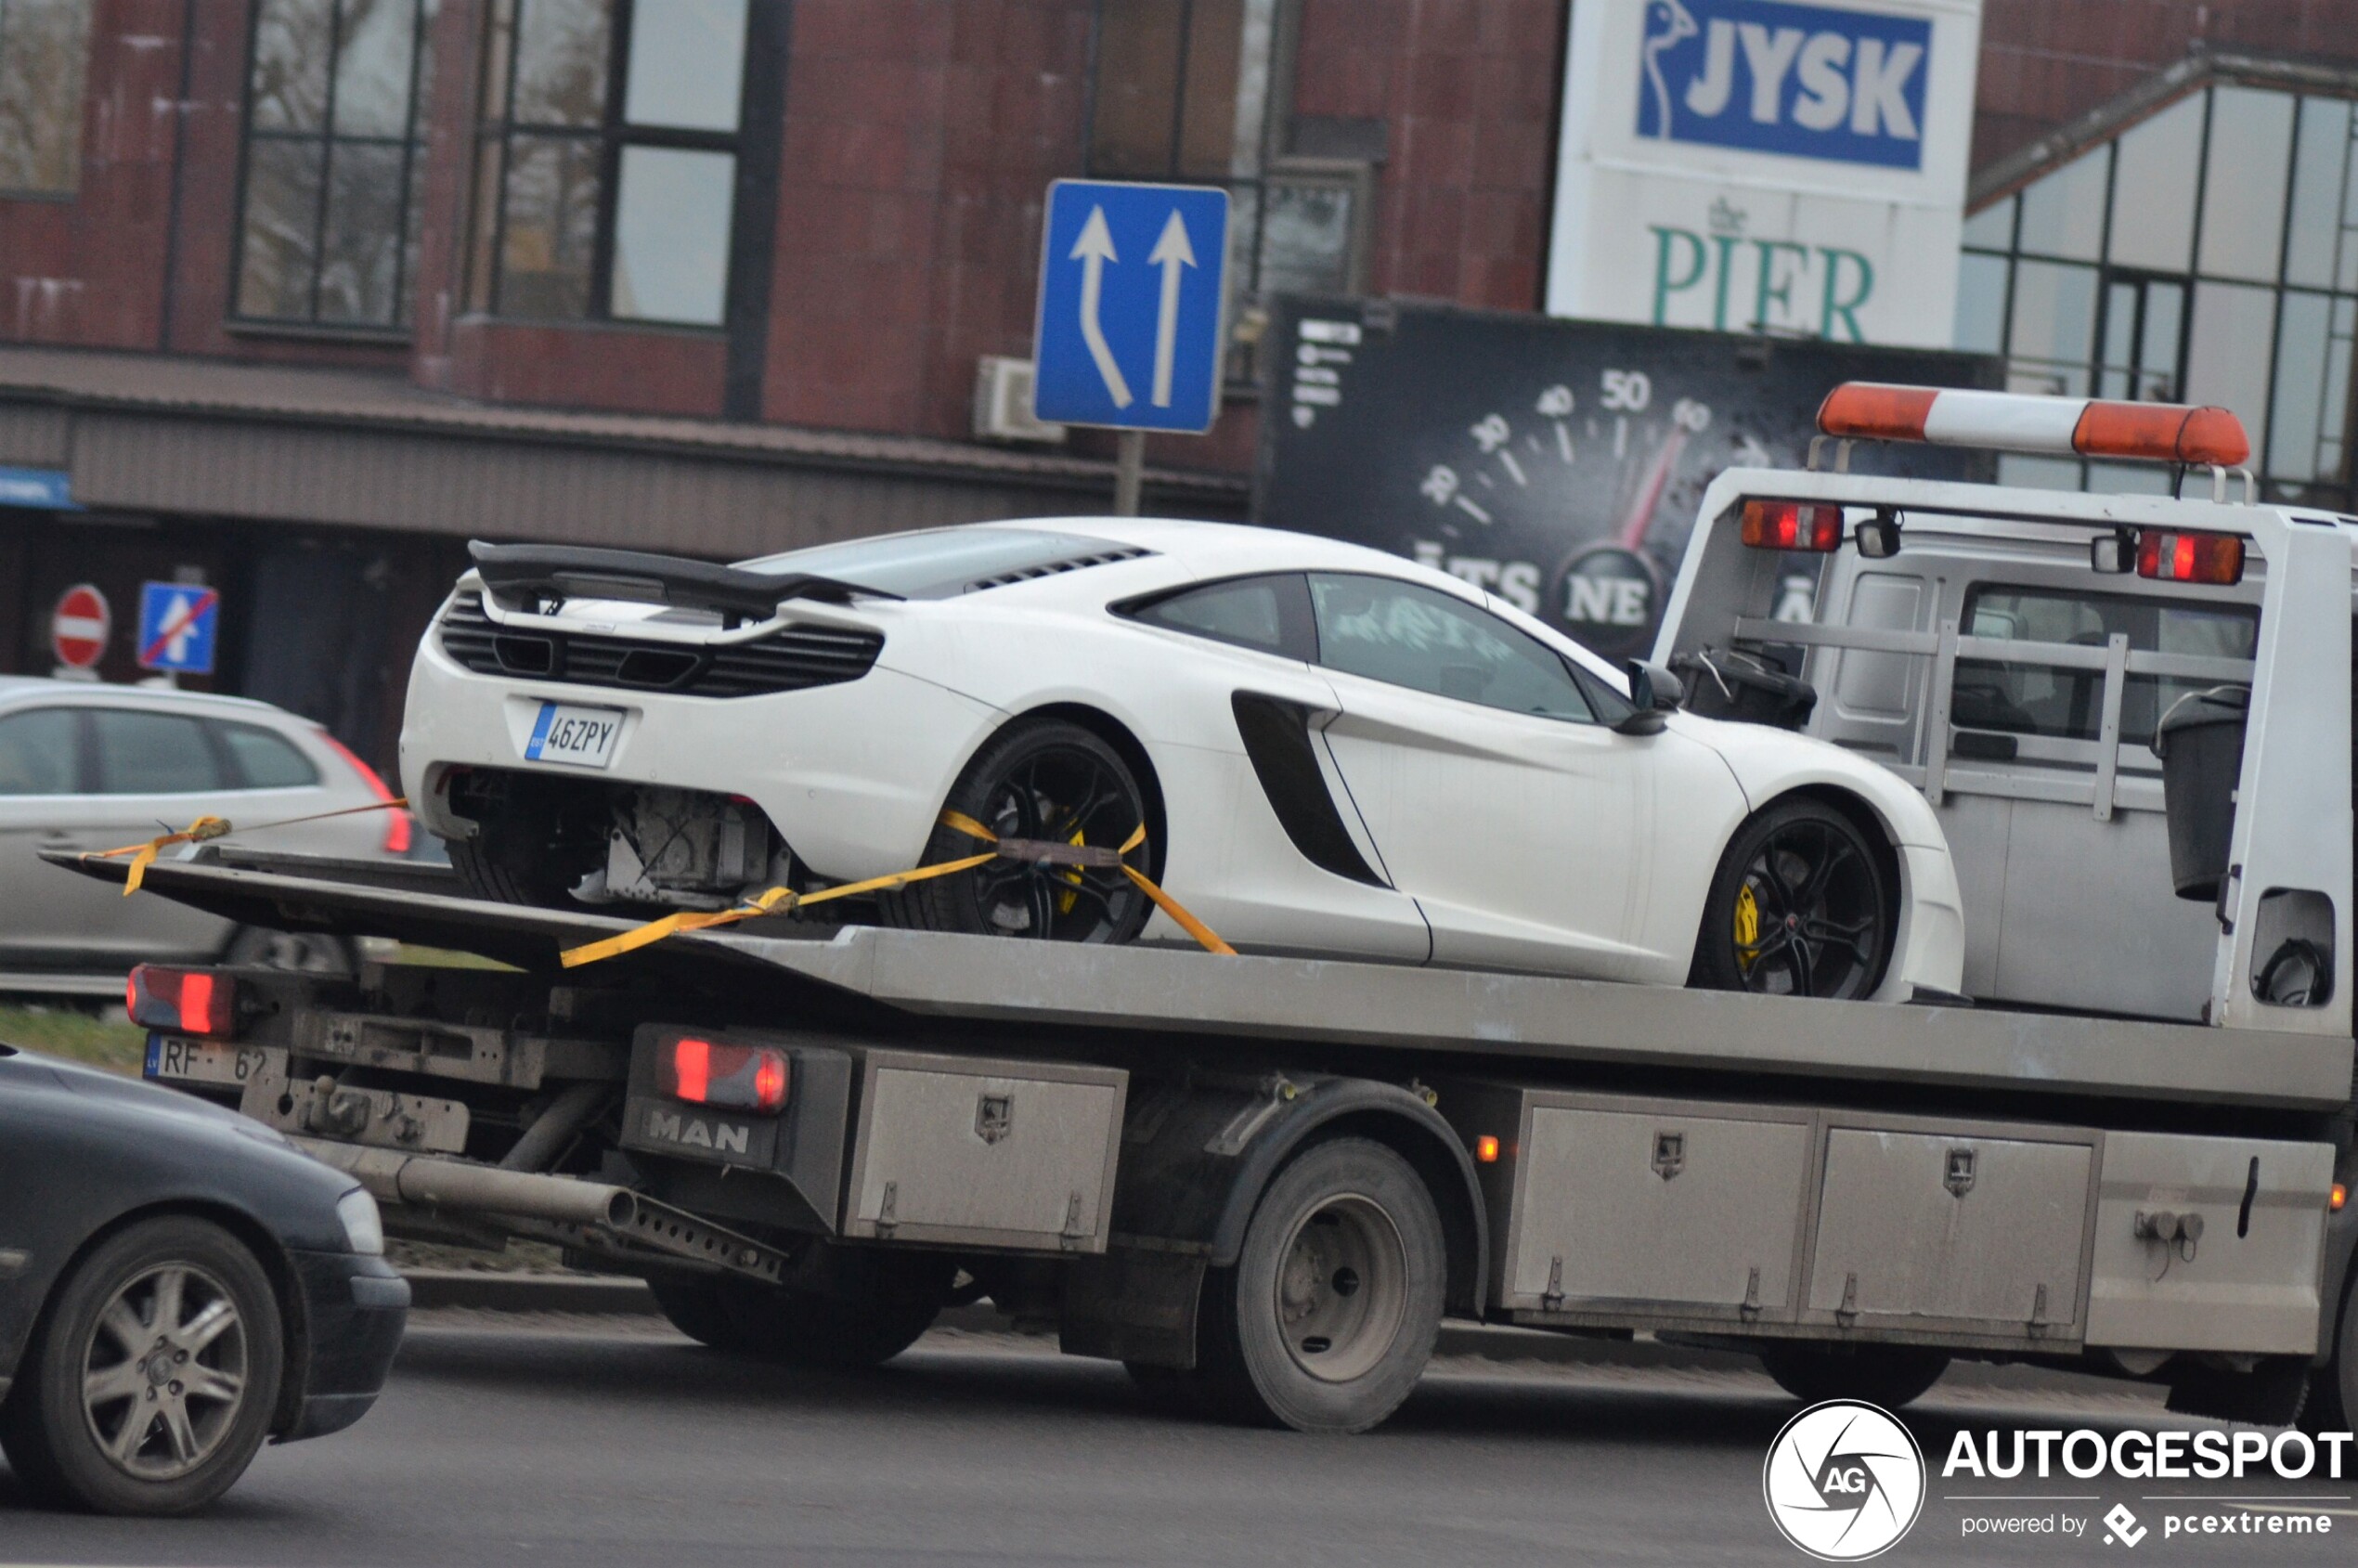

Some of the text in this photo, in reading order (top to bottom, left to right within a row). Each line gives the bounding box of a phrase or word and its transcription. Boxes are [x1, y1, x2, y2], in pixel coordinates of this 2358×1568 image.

[1685, 18, 1924, 141] JYSK
[1647, 224, 1874, 344] PIER
[1601, 369, 1651, 412] 50
[1563, 573, 1646, 627] NE
[549, 717, 614, 754] 46ZPY
[650, 1111, 749, 1154] MAN
